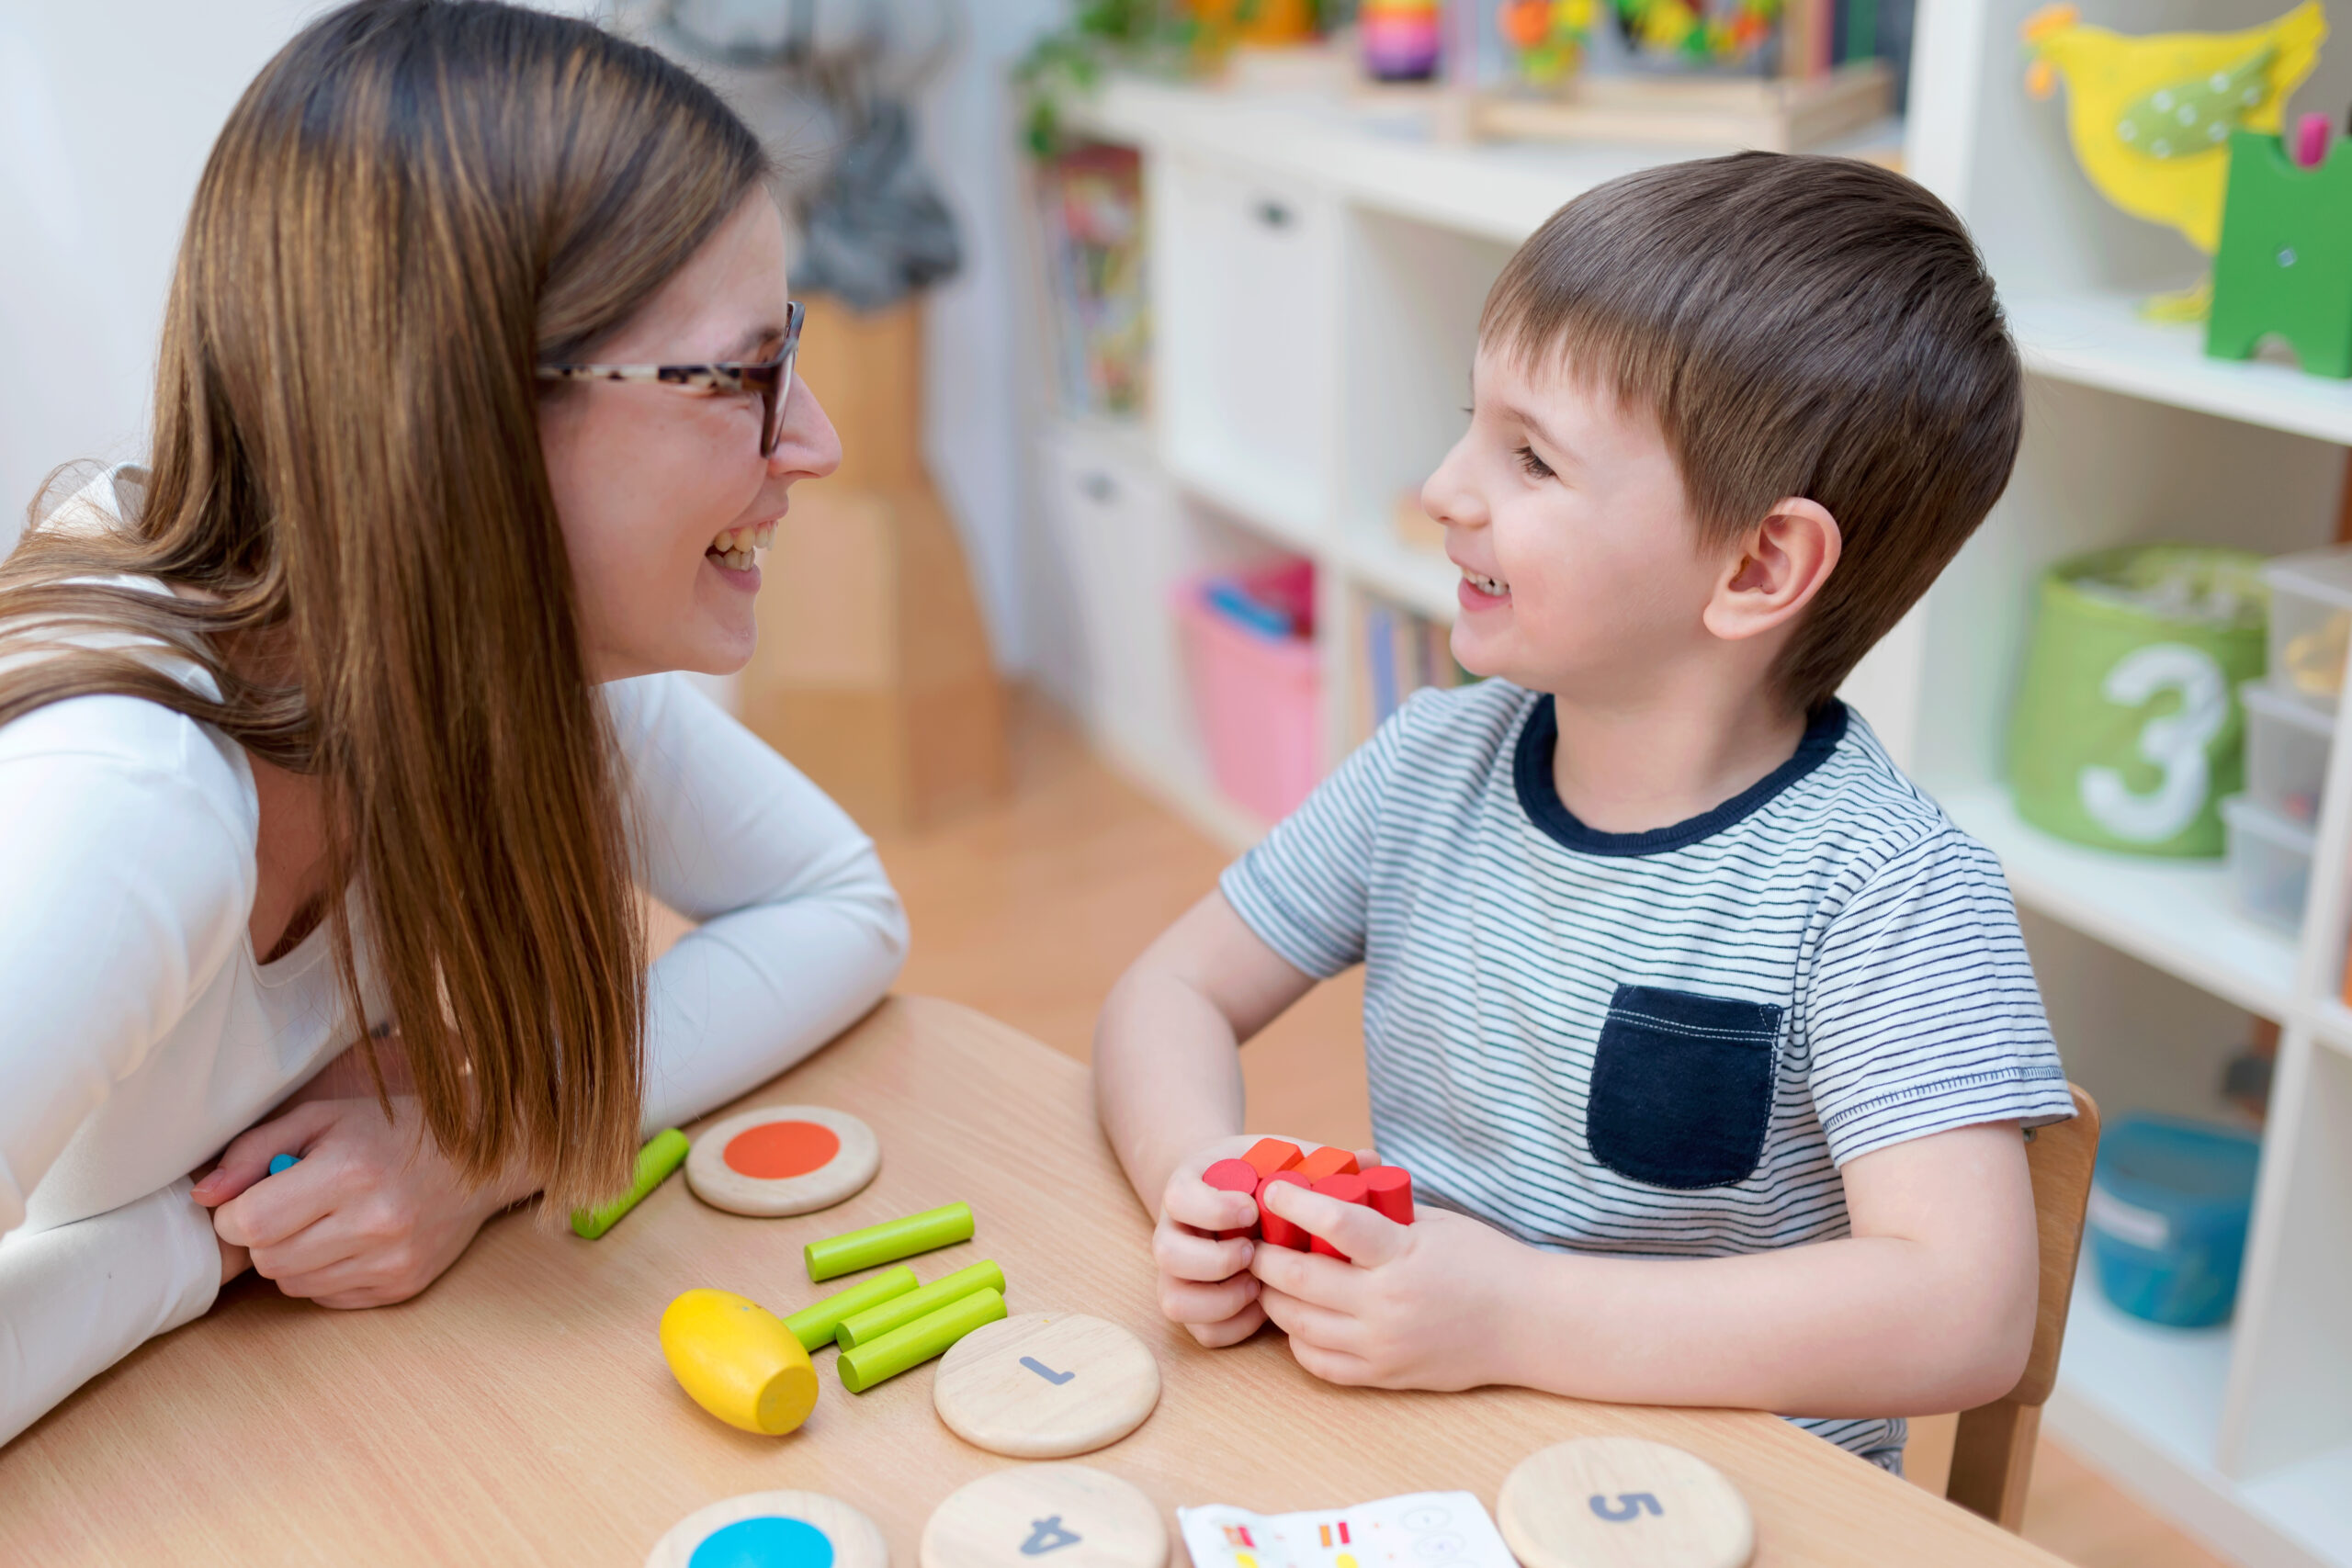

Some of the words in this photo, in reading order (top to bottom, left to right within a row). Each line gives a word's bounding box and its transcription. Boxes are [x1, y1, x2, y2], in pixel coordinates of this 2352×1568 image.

[2078, 642, 2229, 842] 3
[1018, 1356, 1075, 1385] 1
[1589, 1493, 1664, 1521] 5
[1020, 1516, 1081, 1555] 4
